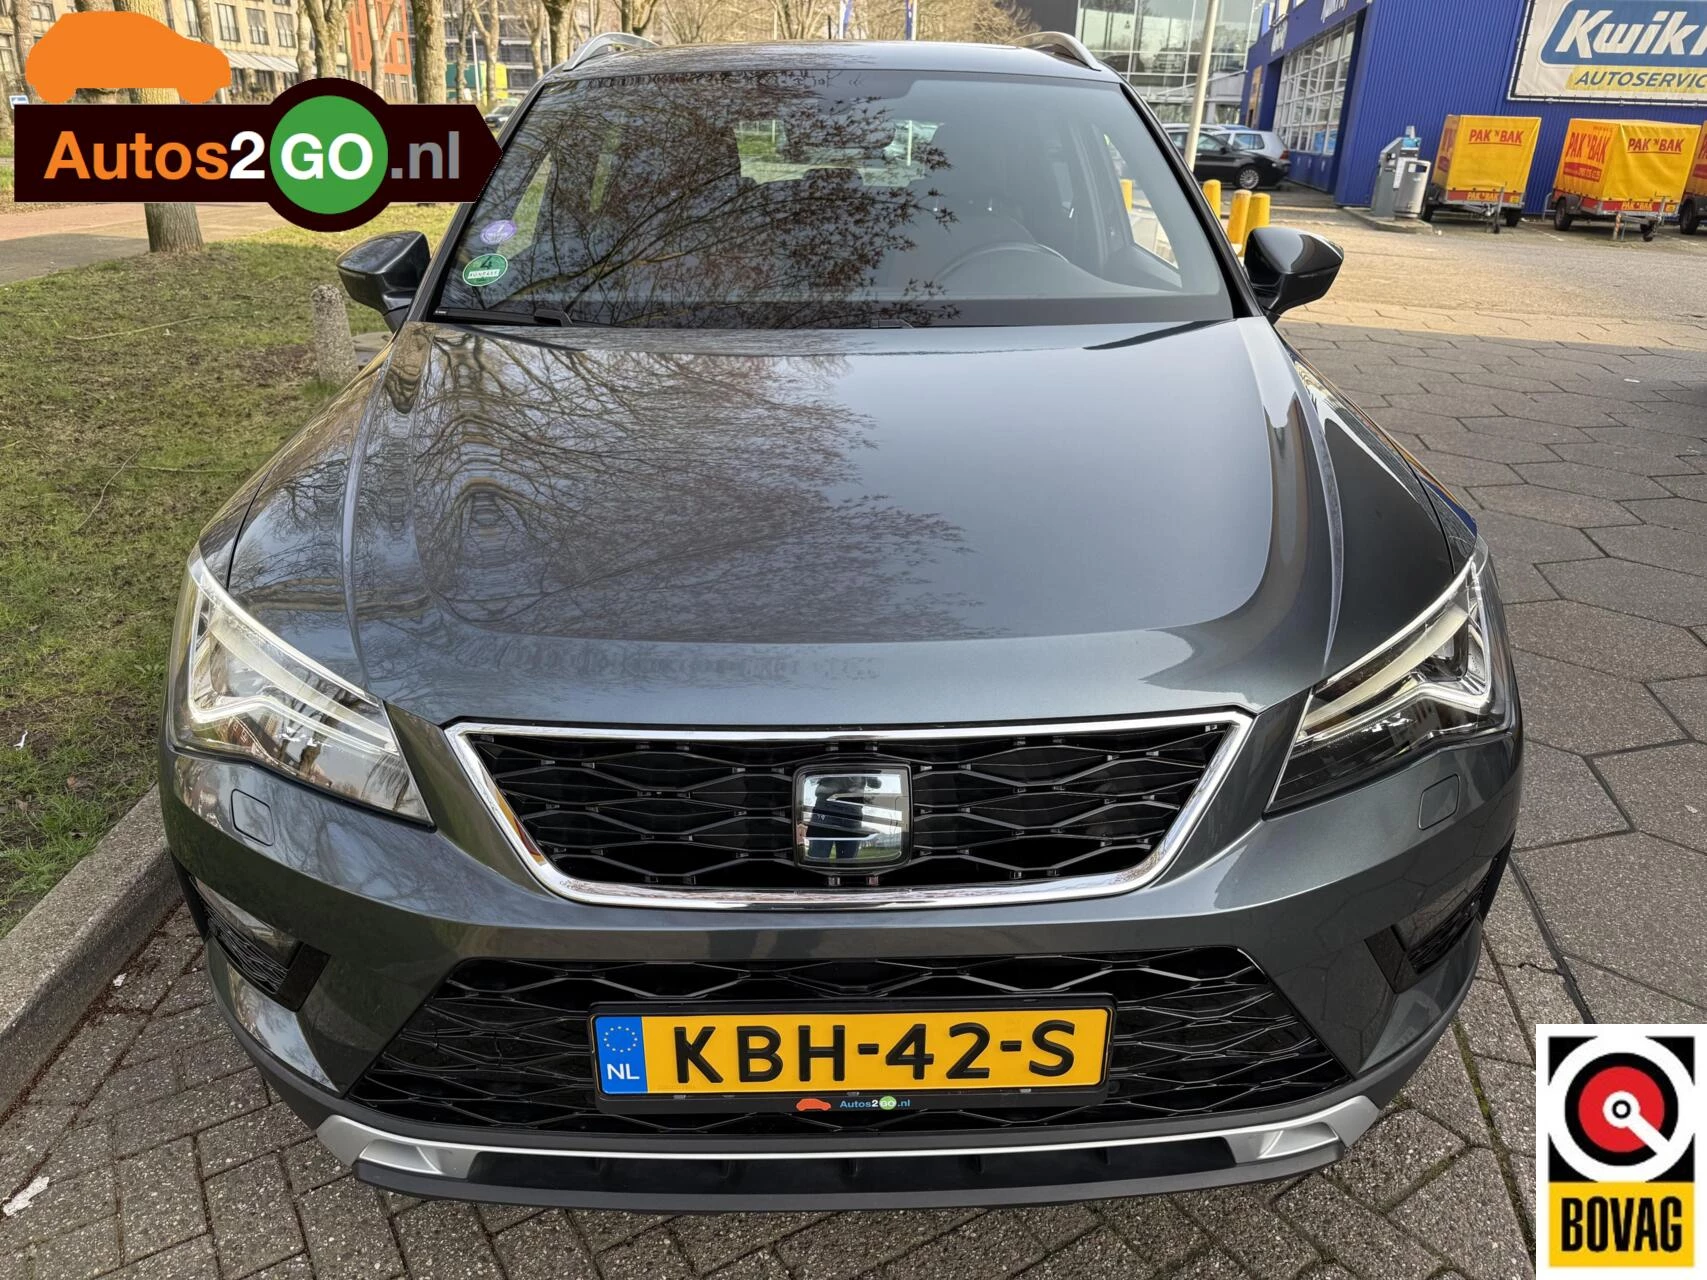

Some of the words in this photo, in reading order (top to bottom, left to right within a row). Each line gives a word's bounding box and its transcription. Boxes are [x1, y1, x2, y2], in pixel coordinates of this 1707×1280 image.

[1469, 129, 1493, 142] PAK
[1500, 130, 1524, 143] BAK
[1628, 138, 1651, 151] PAK
[1659, 138, 1685, 152] BAK
[607, 1063, 640, 1081] NL
[673, 1019, 1076, 1084] KBH-42-S
